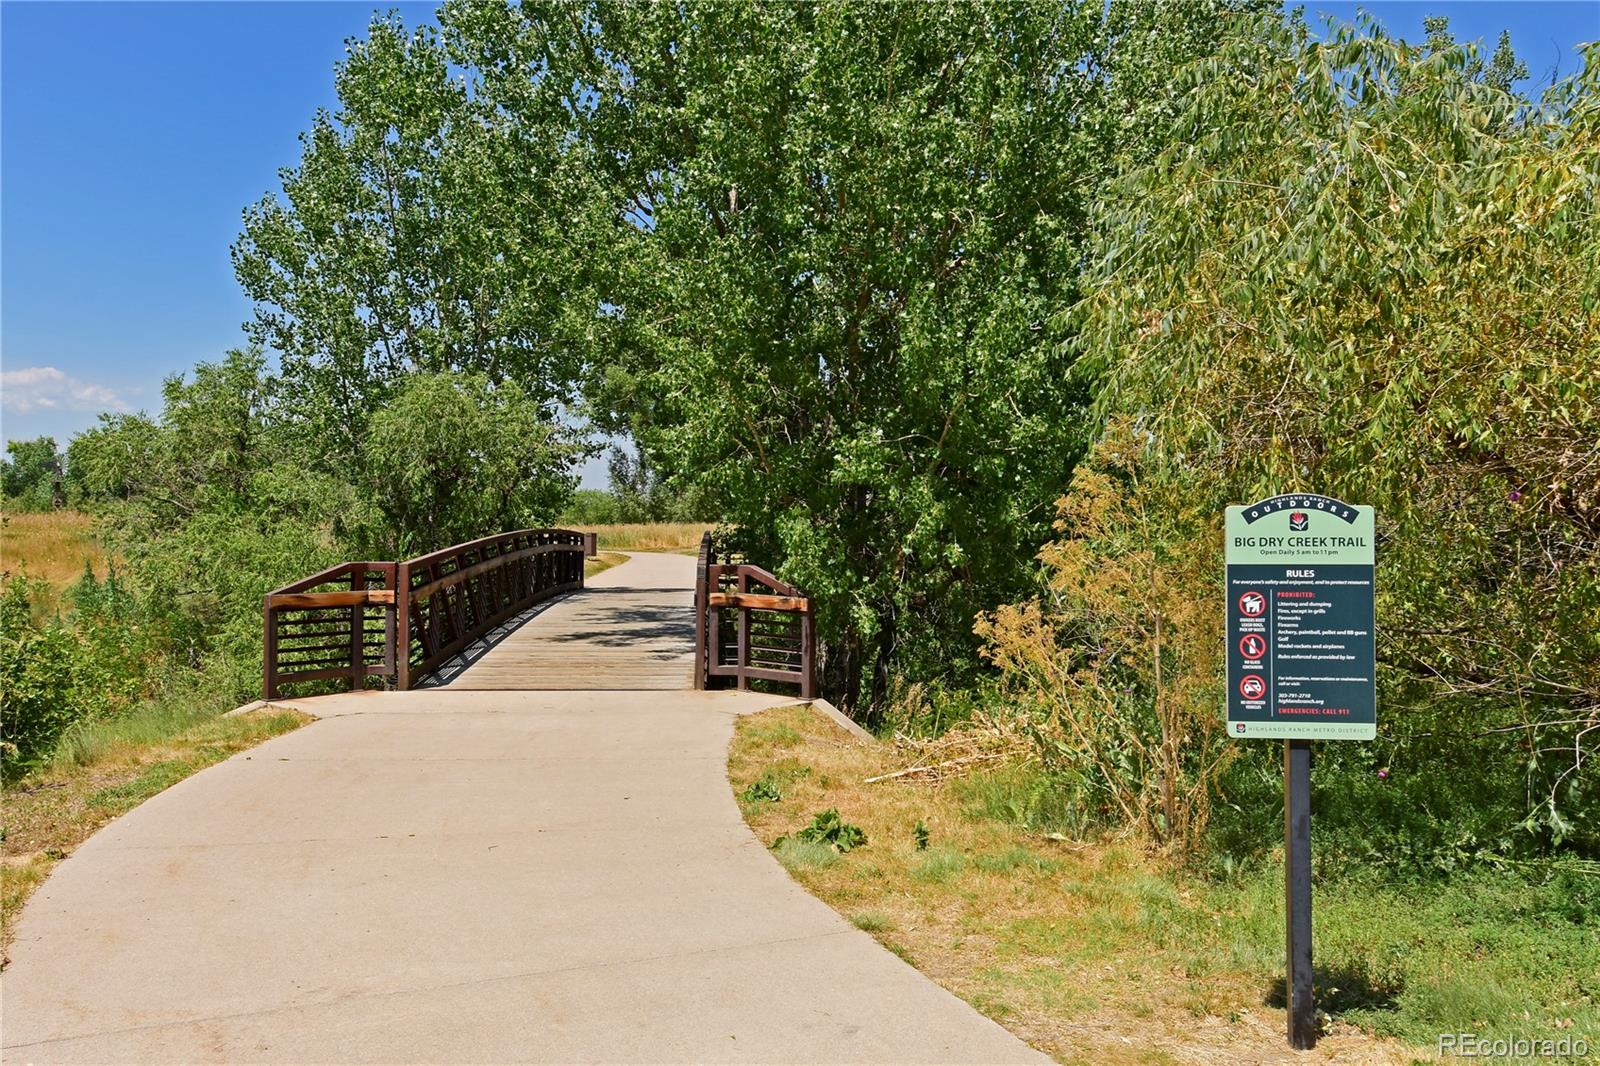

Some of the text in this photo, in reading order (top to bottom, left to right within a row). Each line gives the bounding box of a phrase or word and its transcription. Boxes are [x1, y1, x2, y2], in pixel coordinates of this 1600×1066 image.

[1270, 496, 1330, 504] HIGHLANDS RANCH
[1251, 500, 1349, 518] OUTDOORS
[1234, 537, 1366, 547] BIG DRY CREEK TRAIL
[1286, 570, 1315, 578] RULES
